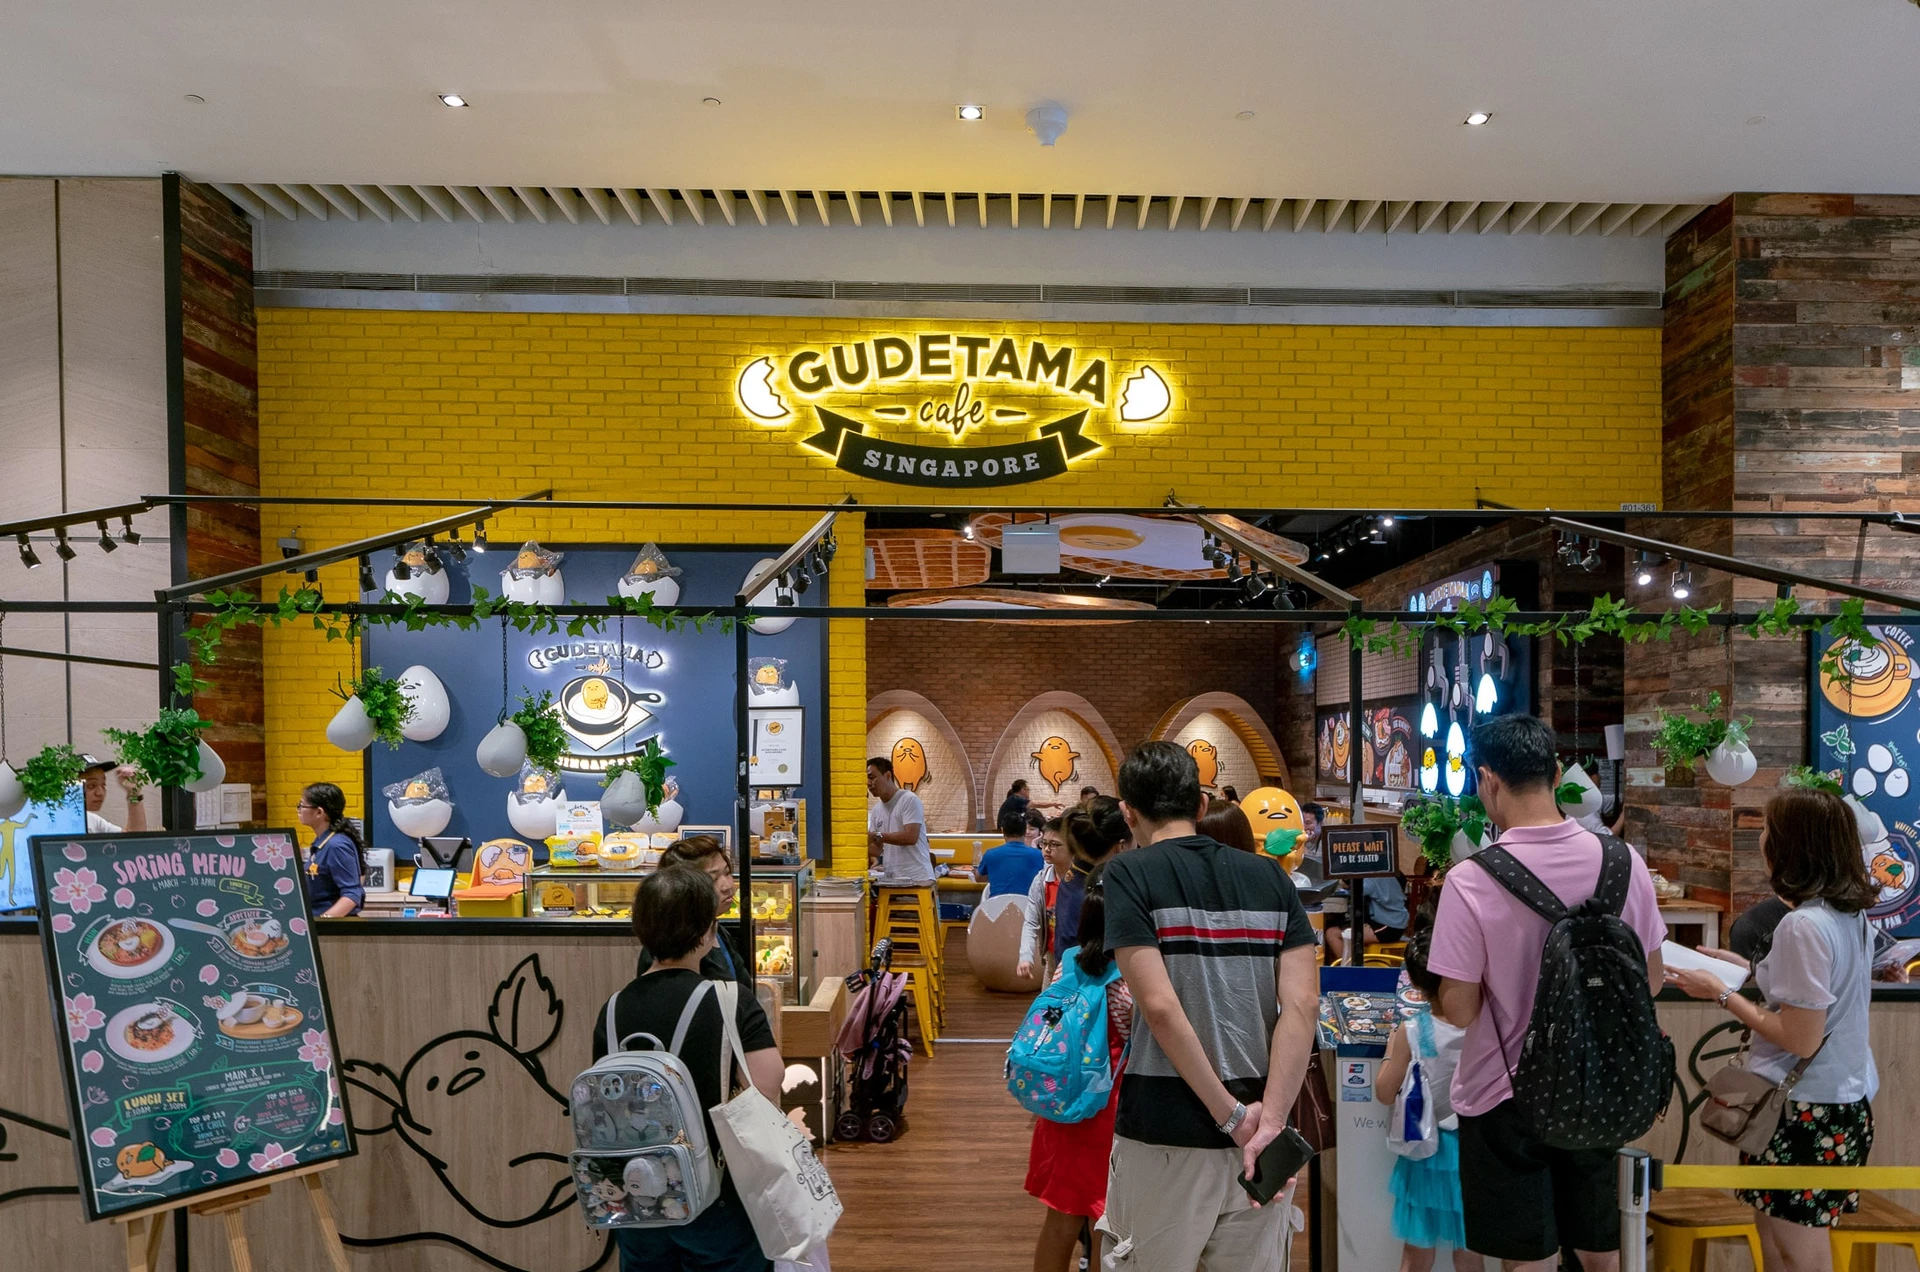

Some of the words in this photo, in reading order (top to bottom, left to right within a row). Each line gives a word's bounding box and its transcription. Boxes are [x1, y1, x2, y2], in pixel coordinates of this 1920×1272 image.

[788, 333, 1106, 405] GUDETAMA
[919, 382, 985, 434] cafe
[862, 448, 1041, 479] SINGAPORE
[1884, 625, 1915, 649] COFFEE
[543, 642, 644, 663] GUDETAMA
[1332, 841, 1361, 853] PLEASE
[192, 852, 246, 878] MENU
[1339, 855, 1347, 864] TO
[1348, 855, 1356, 863] BE
[1357, 853, 1379, 863] SEATED
[157, 878, 179, 890] MARCH
[189, 877, 199, 886] 30
[200, 877, 217, 887] APRIL
[1884, 914, 1902, 930] PAN
[224, 1069, 247, 1082] MAIN
[123, 1092, 162, 1110] LUNCH
[166, 1091, 186, 1103] SET
[1353, 1116, 1374, 1129] We
